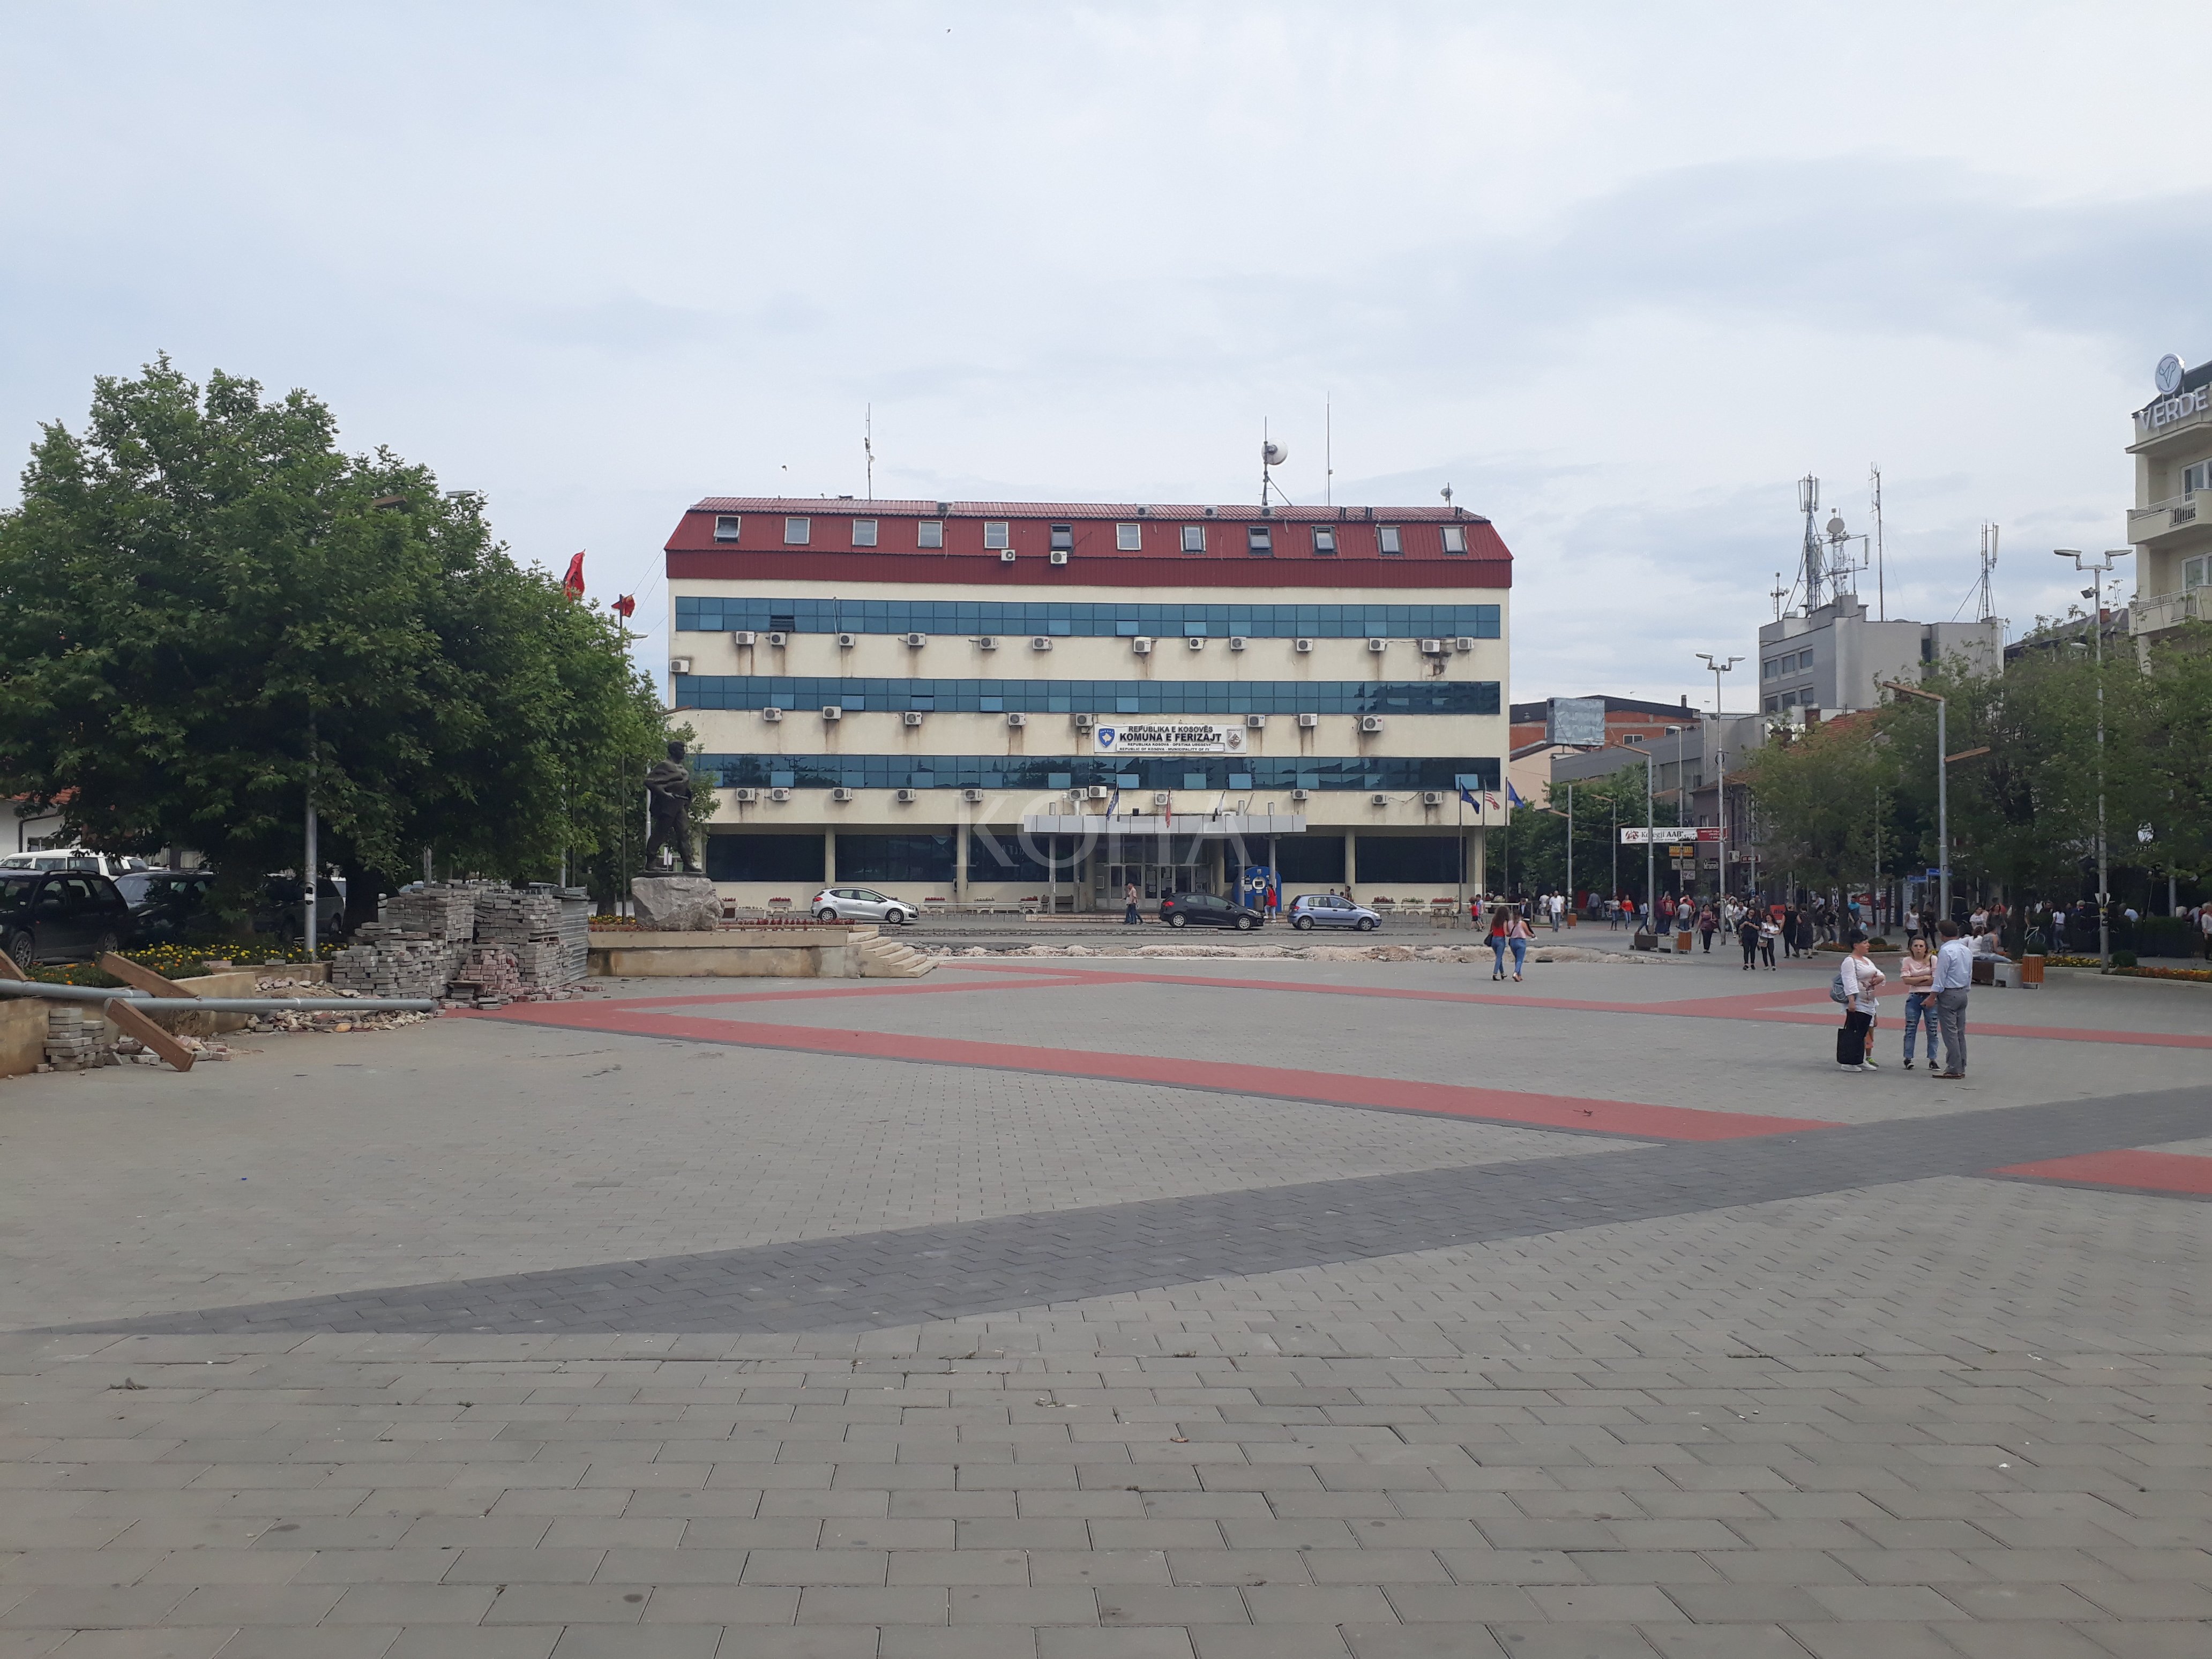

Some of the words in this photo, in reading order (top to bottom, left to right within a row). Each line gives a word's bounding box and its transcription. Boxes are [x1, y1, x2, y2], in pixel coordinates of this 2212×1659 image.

[2138, 384, 2209, 430] VERDE
[1119, 733, 1163, 741] KOMUNA
[1166, 733, 1172, 741] E
[1175, 733, 1222, 742] FERIZAJT
